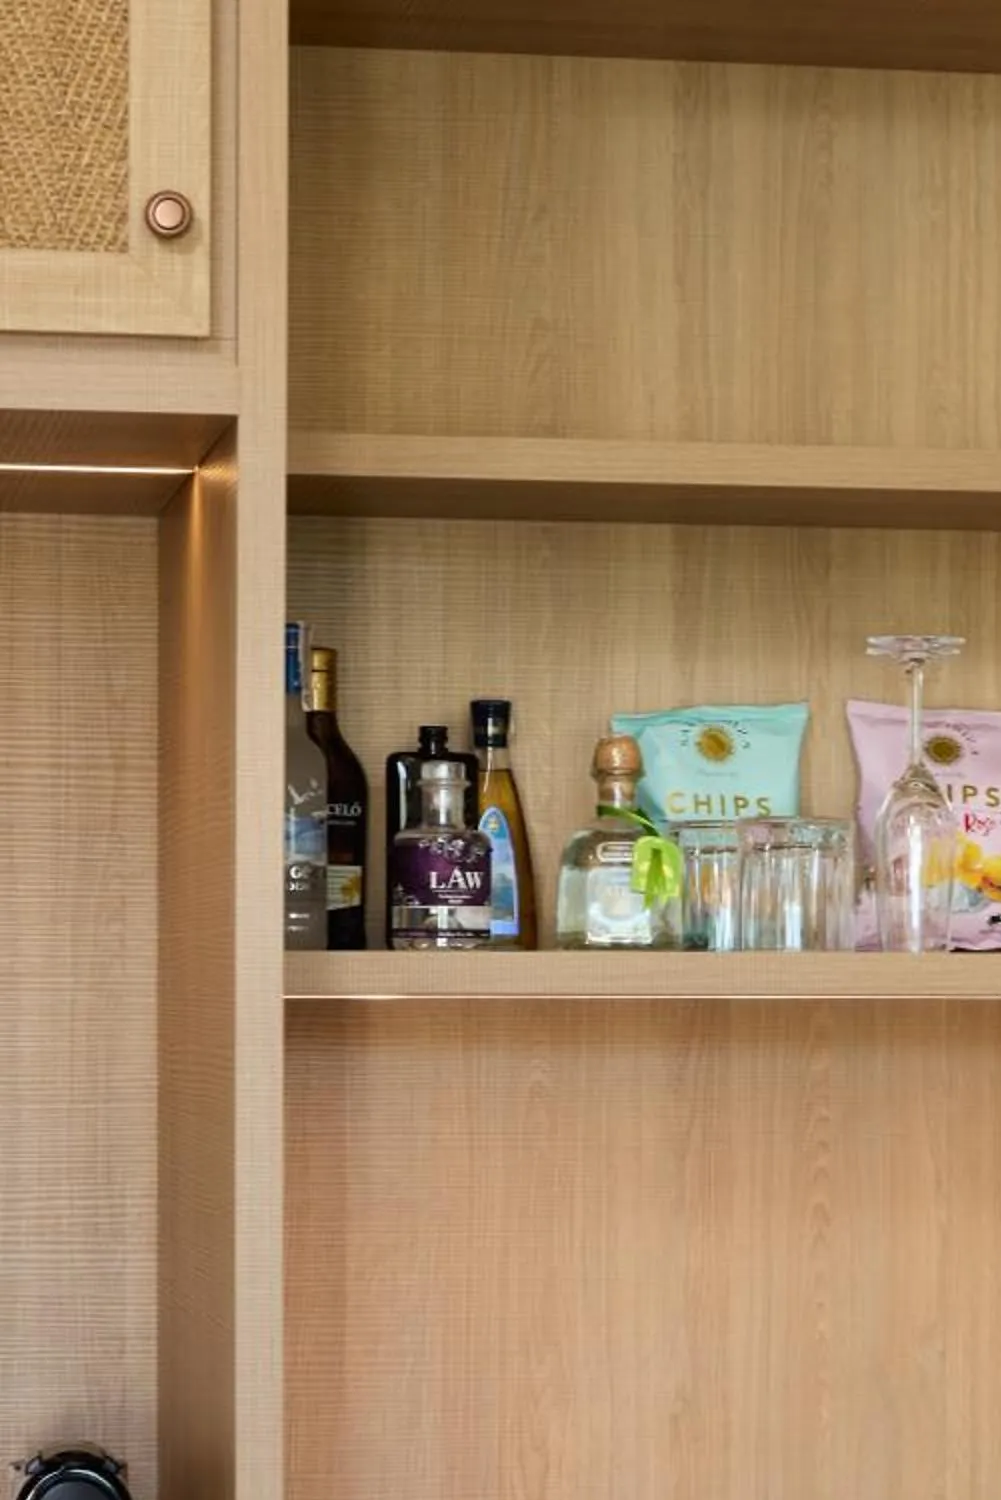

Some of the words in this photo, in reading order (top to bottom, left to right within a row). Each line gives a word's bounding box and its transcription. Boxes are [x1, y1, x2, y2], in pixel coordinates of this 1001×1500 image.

[666, 792, 772, 818] CHIPS
[946, 783, 1001, 808] IPS
[326, 801, 362, 817] CELÓ
[429, 866, 484, 891] LAW
